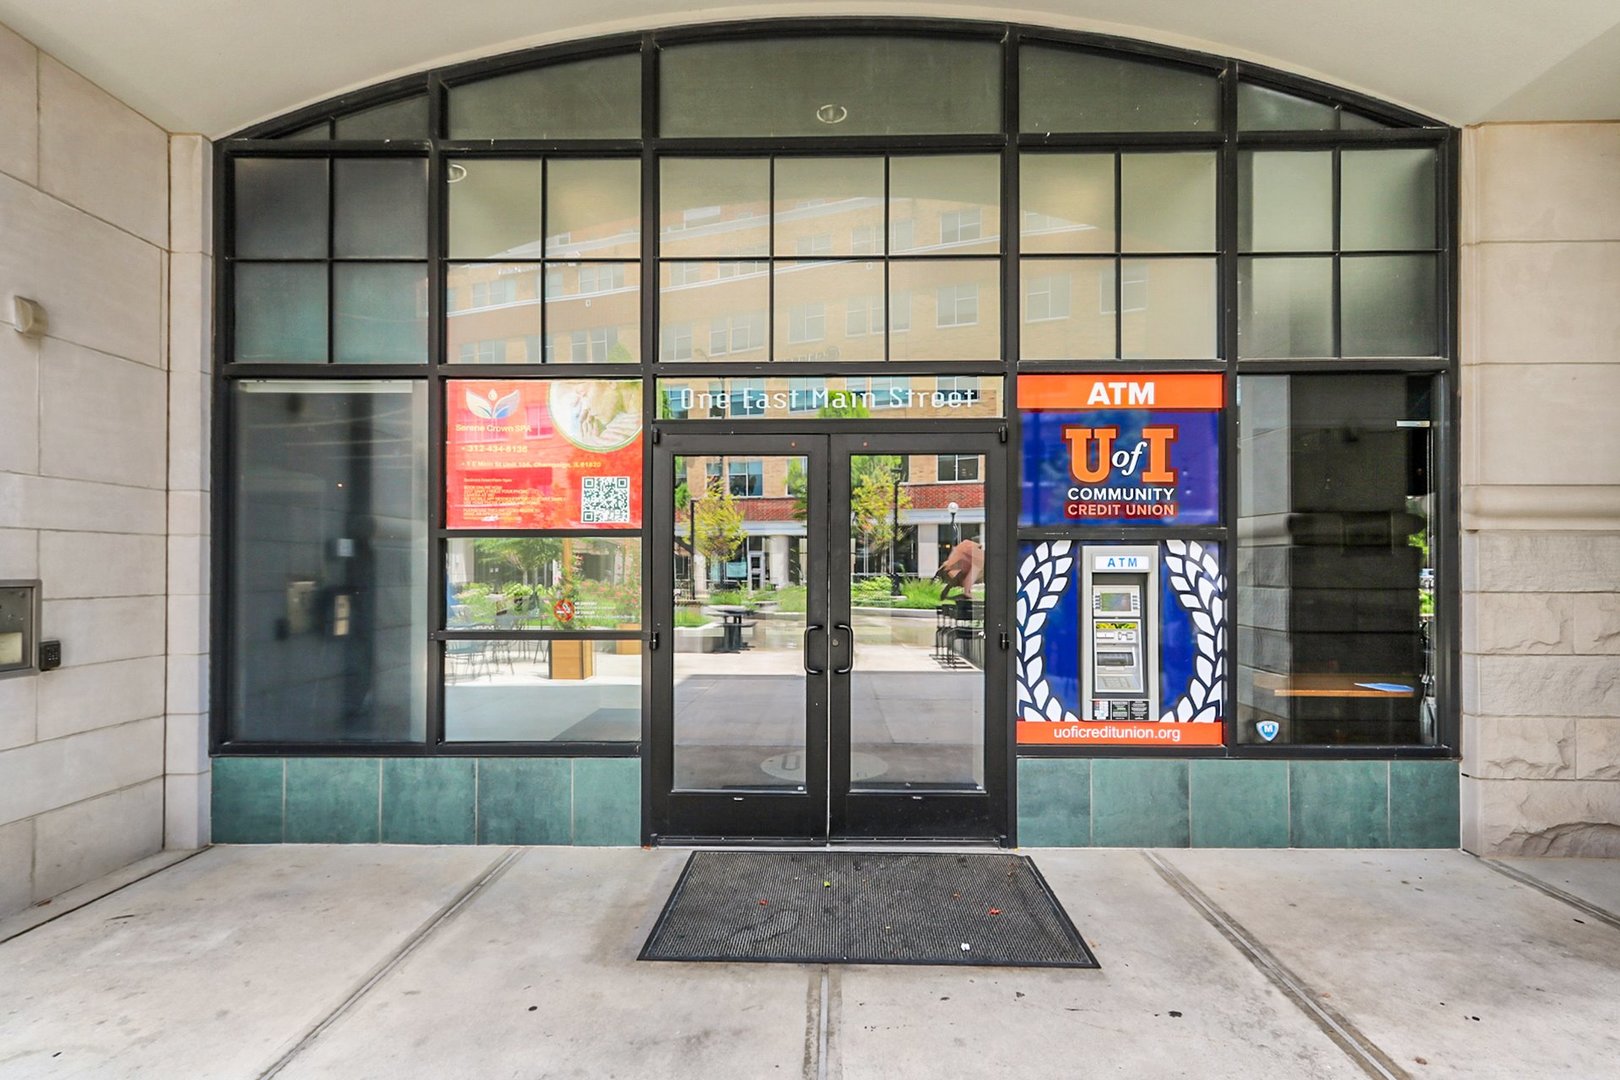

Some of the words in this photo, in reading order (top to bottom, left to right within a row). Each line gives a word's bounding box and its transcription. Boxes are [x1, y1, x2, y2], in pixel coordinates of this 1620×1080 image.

[680, 387, 730, 410] One
[742, 387, 799, 410] East
[812, 387, 877, 410] Main
[889, 387, 975, 409] Street
[1087, 381, 1155, 405] ATM
[455, 424, 485, 432] Serene
[486, 424, 513, 432] Crown
[1065, 428, 1117, 484] U
[1111, 441, 1148, 476] of
[1142, 428, 1175, 484] I
[1067, 487, 1175, 501] COMMUNITY
[1067, 504, 1121, 516] CREDIT
[1126, 504, 1175, 516] UNION
[1107, 557, 1138, 568] ATM
[1053, 725, 1181, 742] uoficreditunion.org
